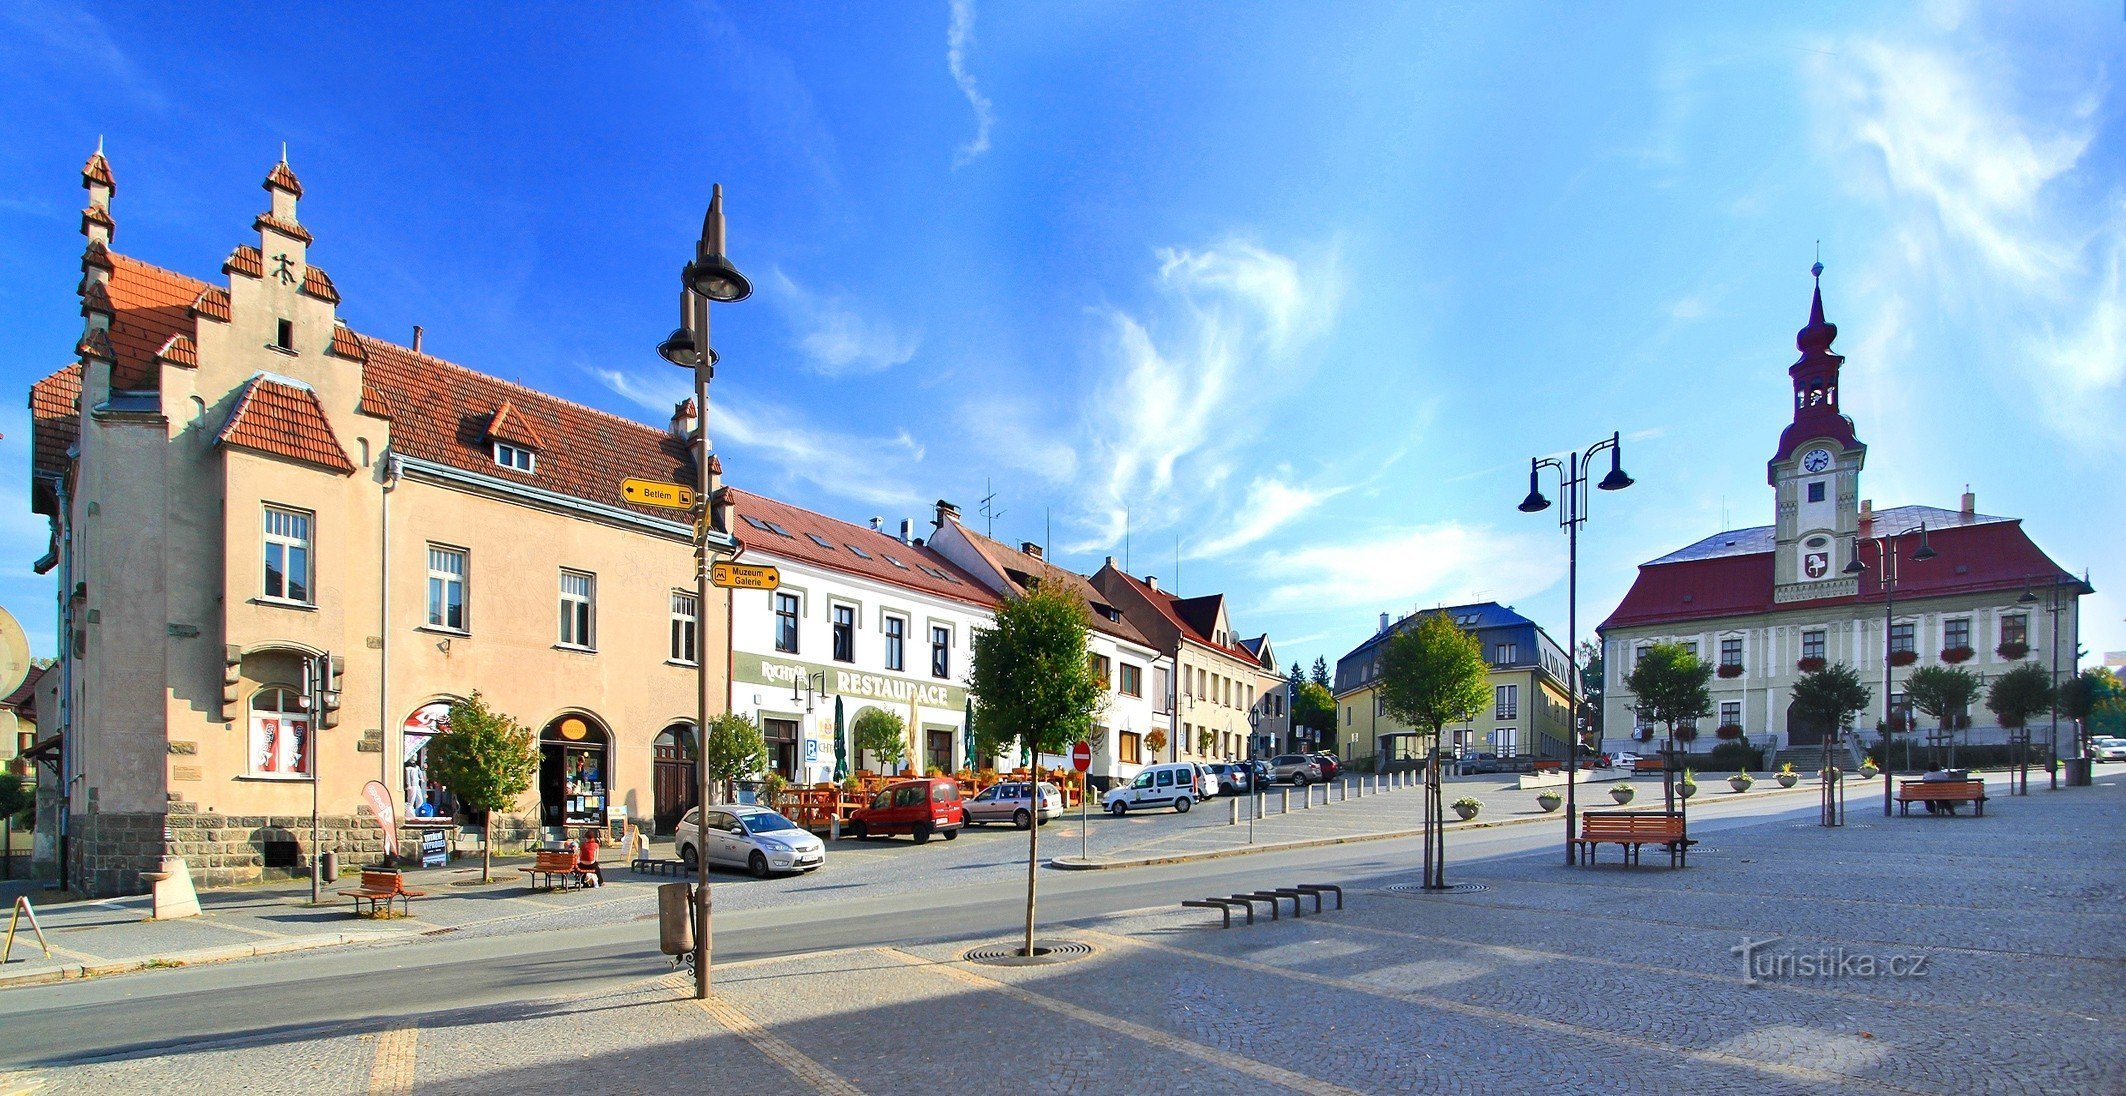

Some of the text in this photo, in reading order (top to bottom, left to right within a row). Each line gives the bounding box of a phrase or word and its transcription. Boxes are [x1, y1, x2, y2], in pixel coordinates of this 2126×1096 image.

[643, 488, 672, 500] Betlém
[732, 567, 764, 578] Muzeum
[734, 576, 762, 587] Galerie
